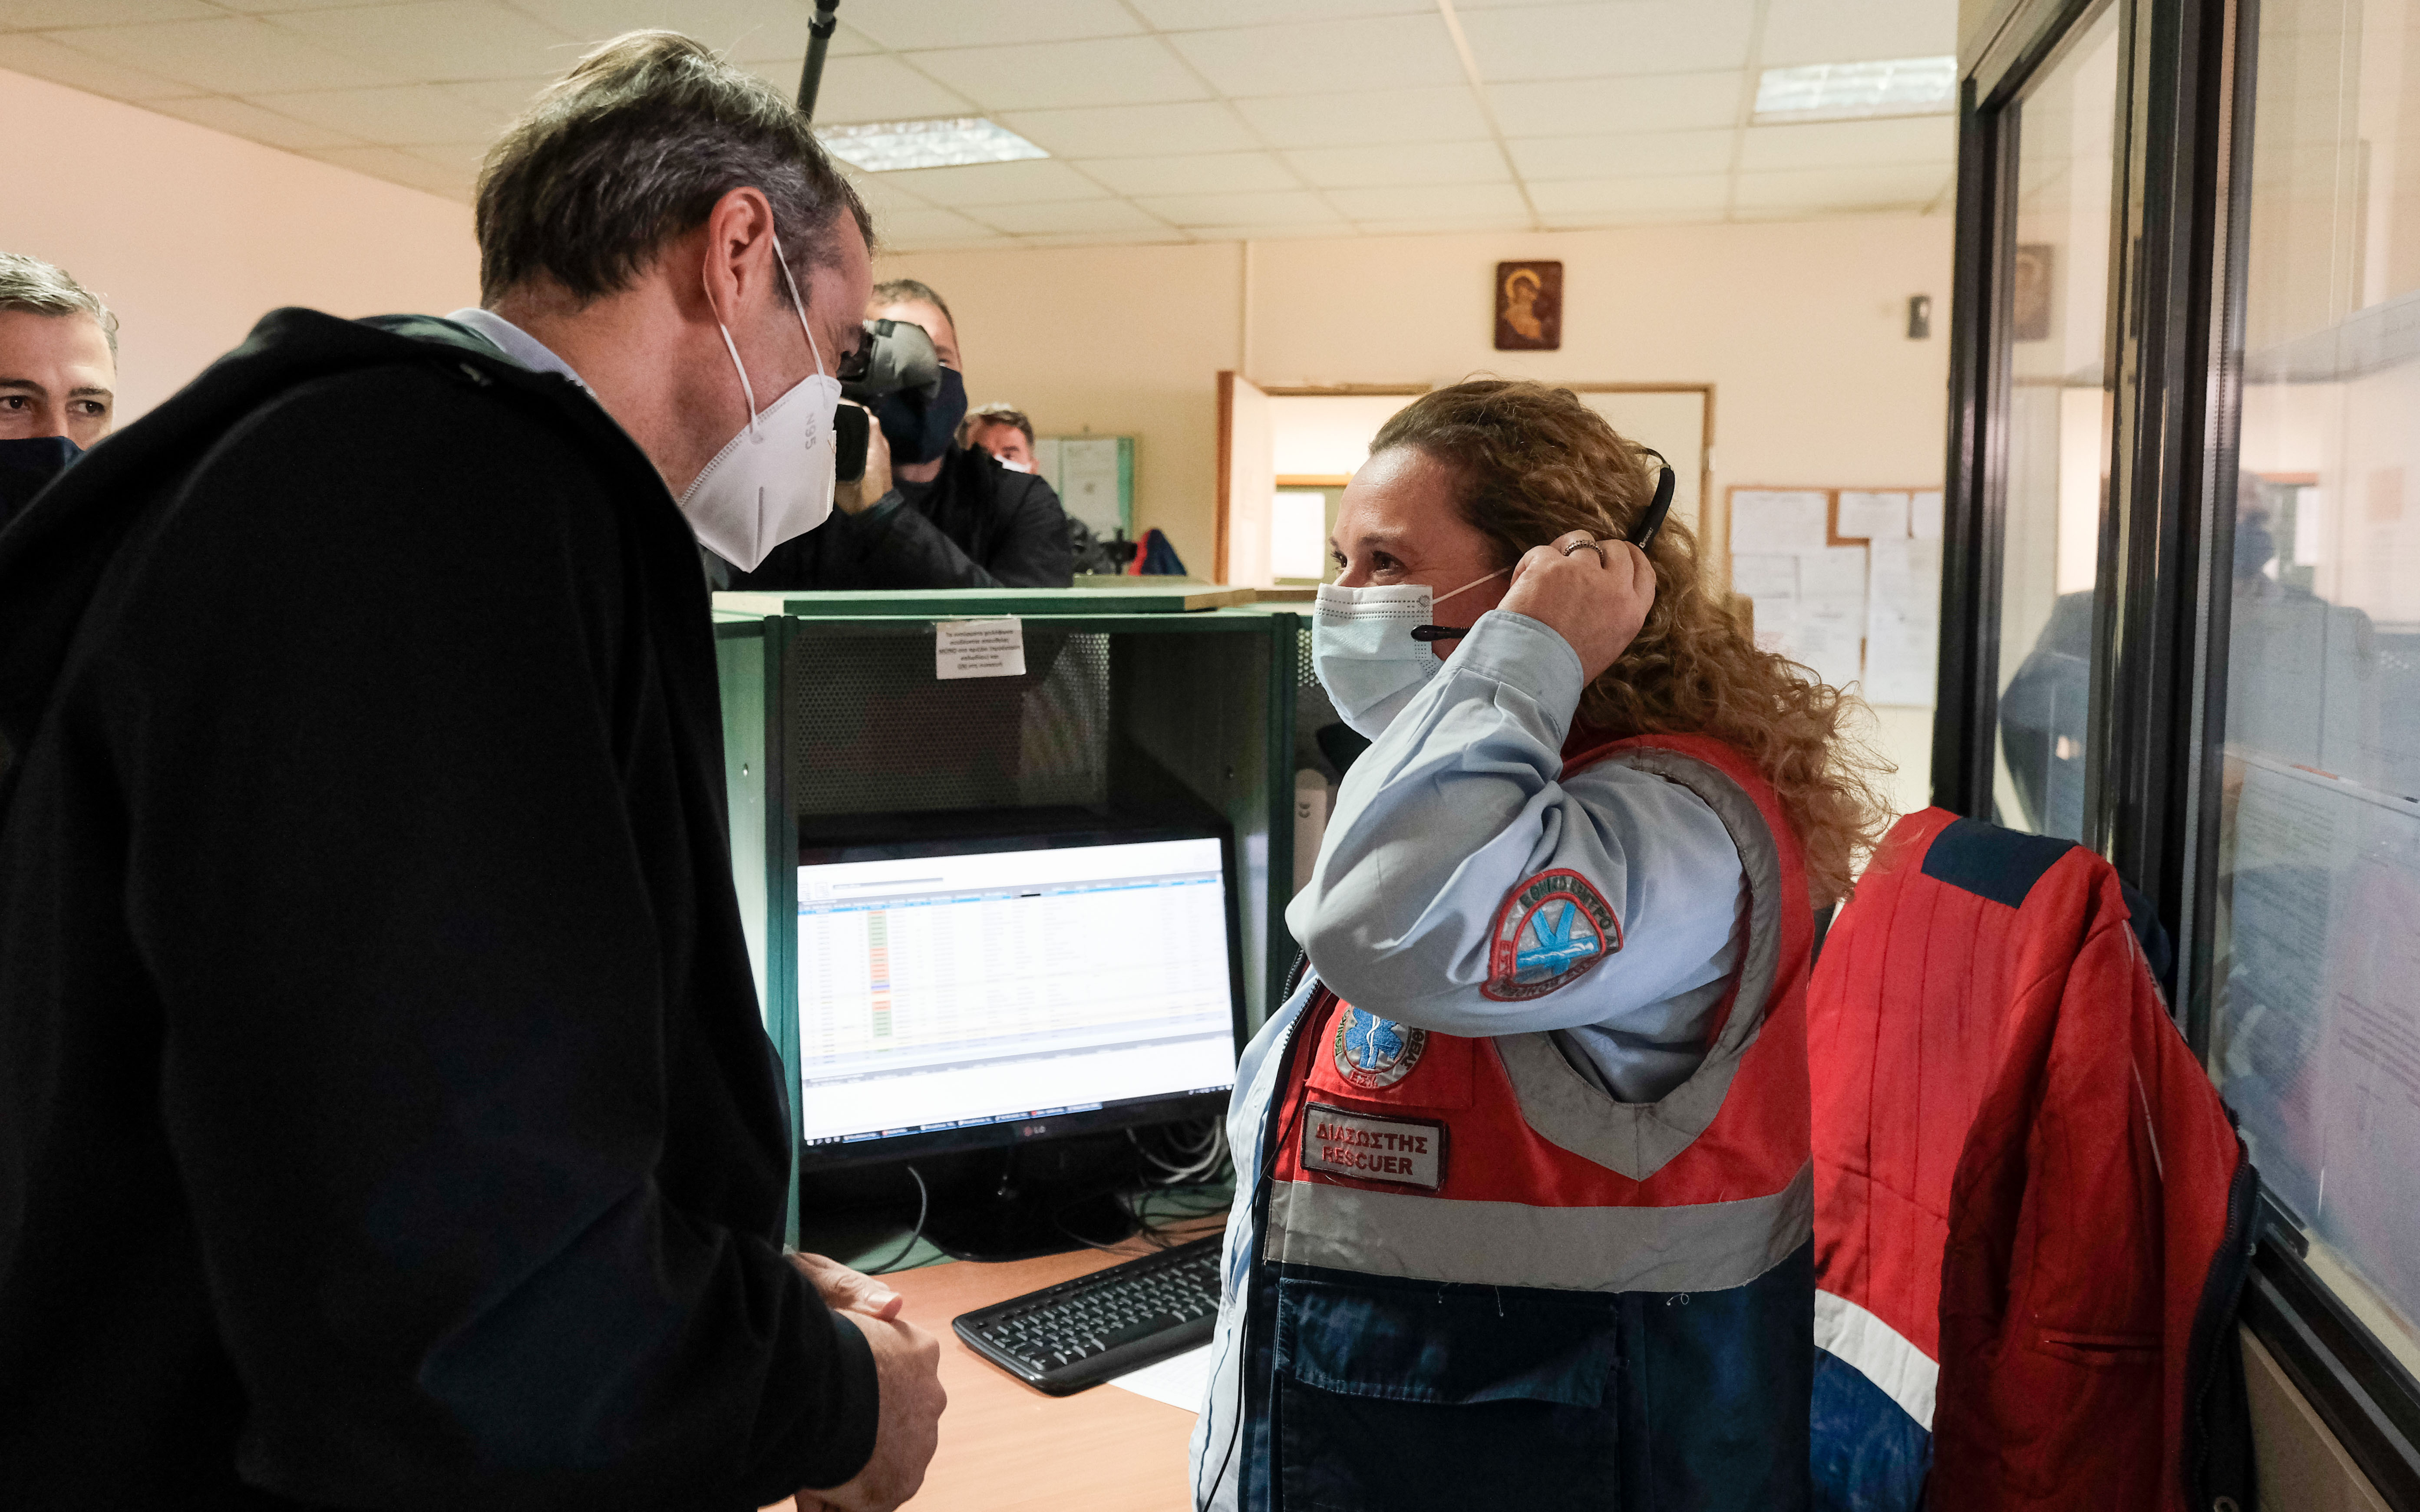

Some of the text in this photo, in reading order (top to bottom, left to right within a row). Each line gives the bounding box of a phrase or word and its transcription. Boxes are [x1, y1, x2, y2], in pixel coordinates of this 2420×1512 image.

[805, 412, 816, 450] N95
[1315, 1122, 1428, 1154] ΔΙΑΣΩΣΤΗΣ
[1322, 1145, 1413, 1176] RESCUER
